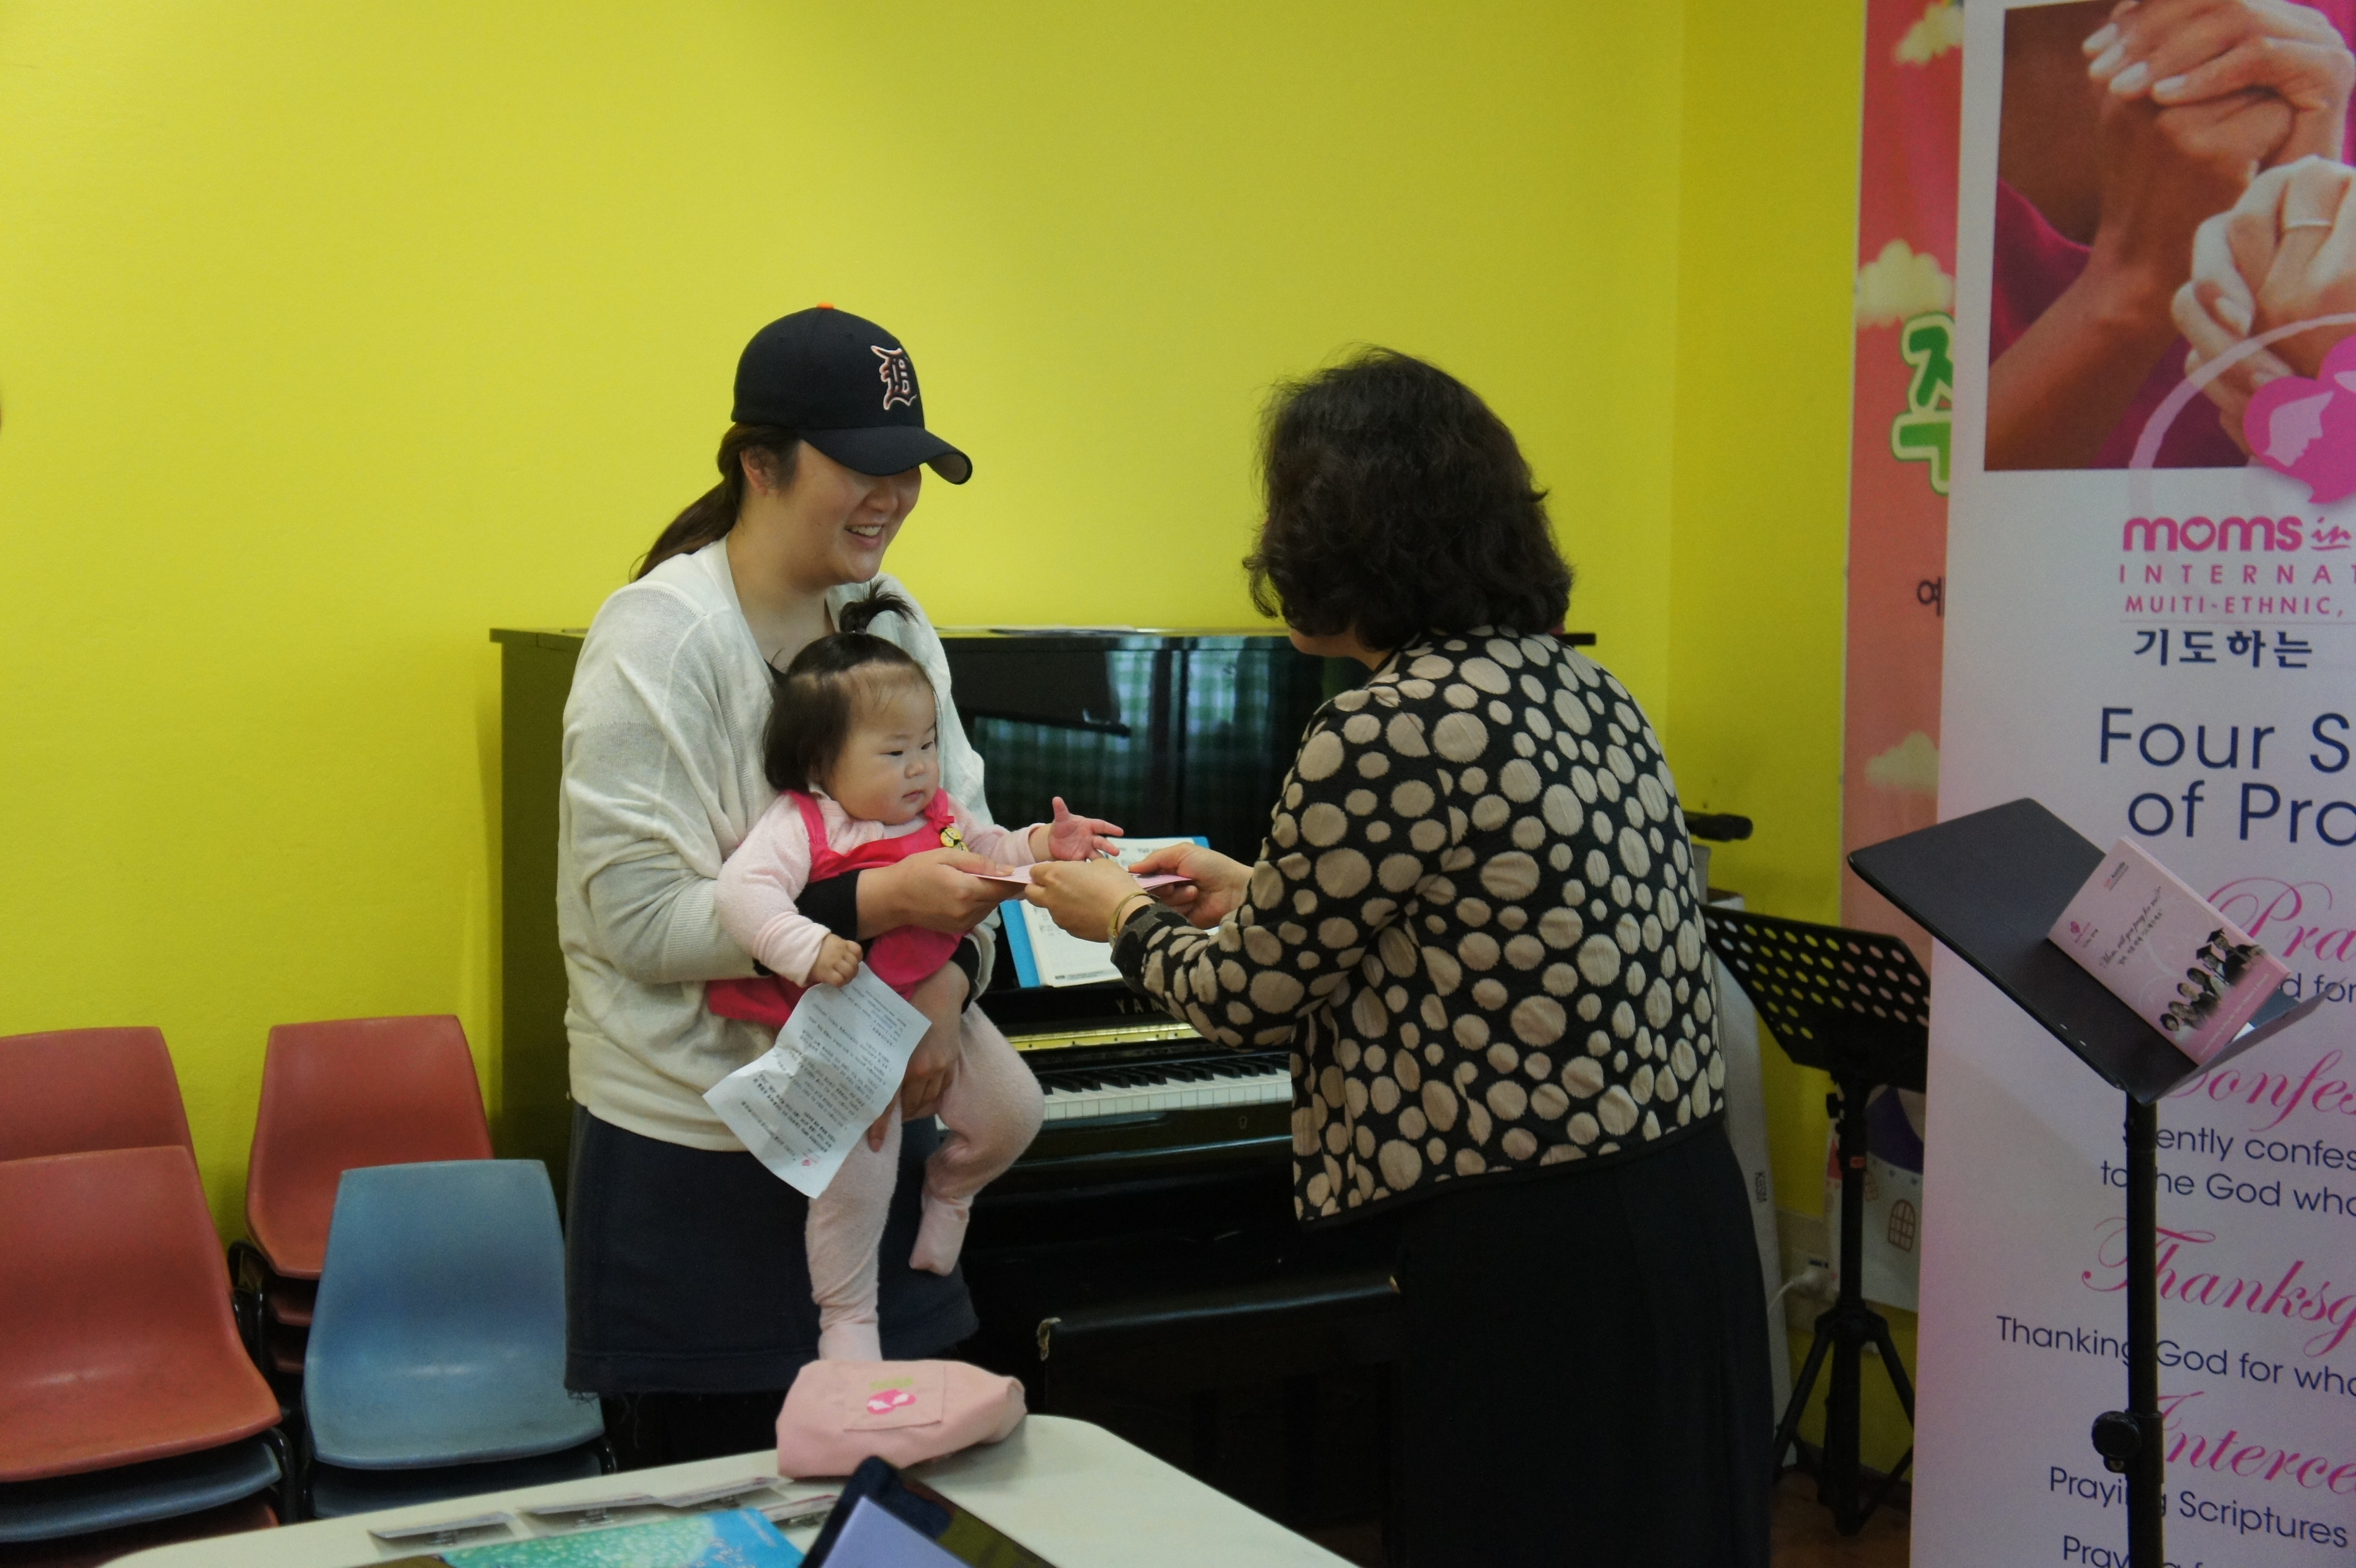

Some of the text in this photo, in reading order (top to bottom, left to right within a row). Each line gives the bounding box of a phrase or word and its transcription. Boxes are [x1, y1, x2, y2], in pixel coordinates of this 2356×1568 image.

[2123, 516, 2351, 552] moms in
[2134, 629, 2313, 668] 기도하는
[2100, 708, 2275, 770] Four
[2128, 780, 2205, 838] of
[2245, 1140, 2356, 1170] confes
[2156, 1166, 2195, 1195] he
[2207, 1173, 2281, 1207] God
[2156, 1340, 2227, 1376] God
[2240, 1353, 2284, 1383] for
[2179, 1491, 2348, 1548] Scriptures
